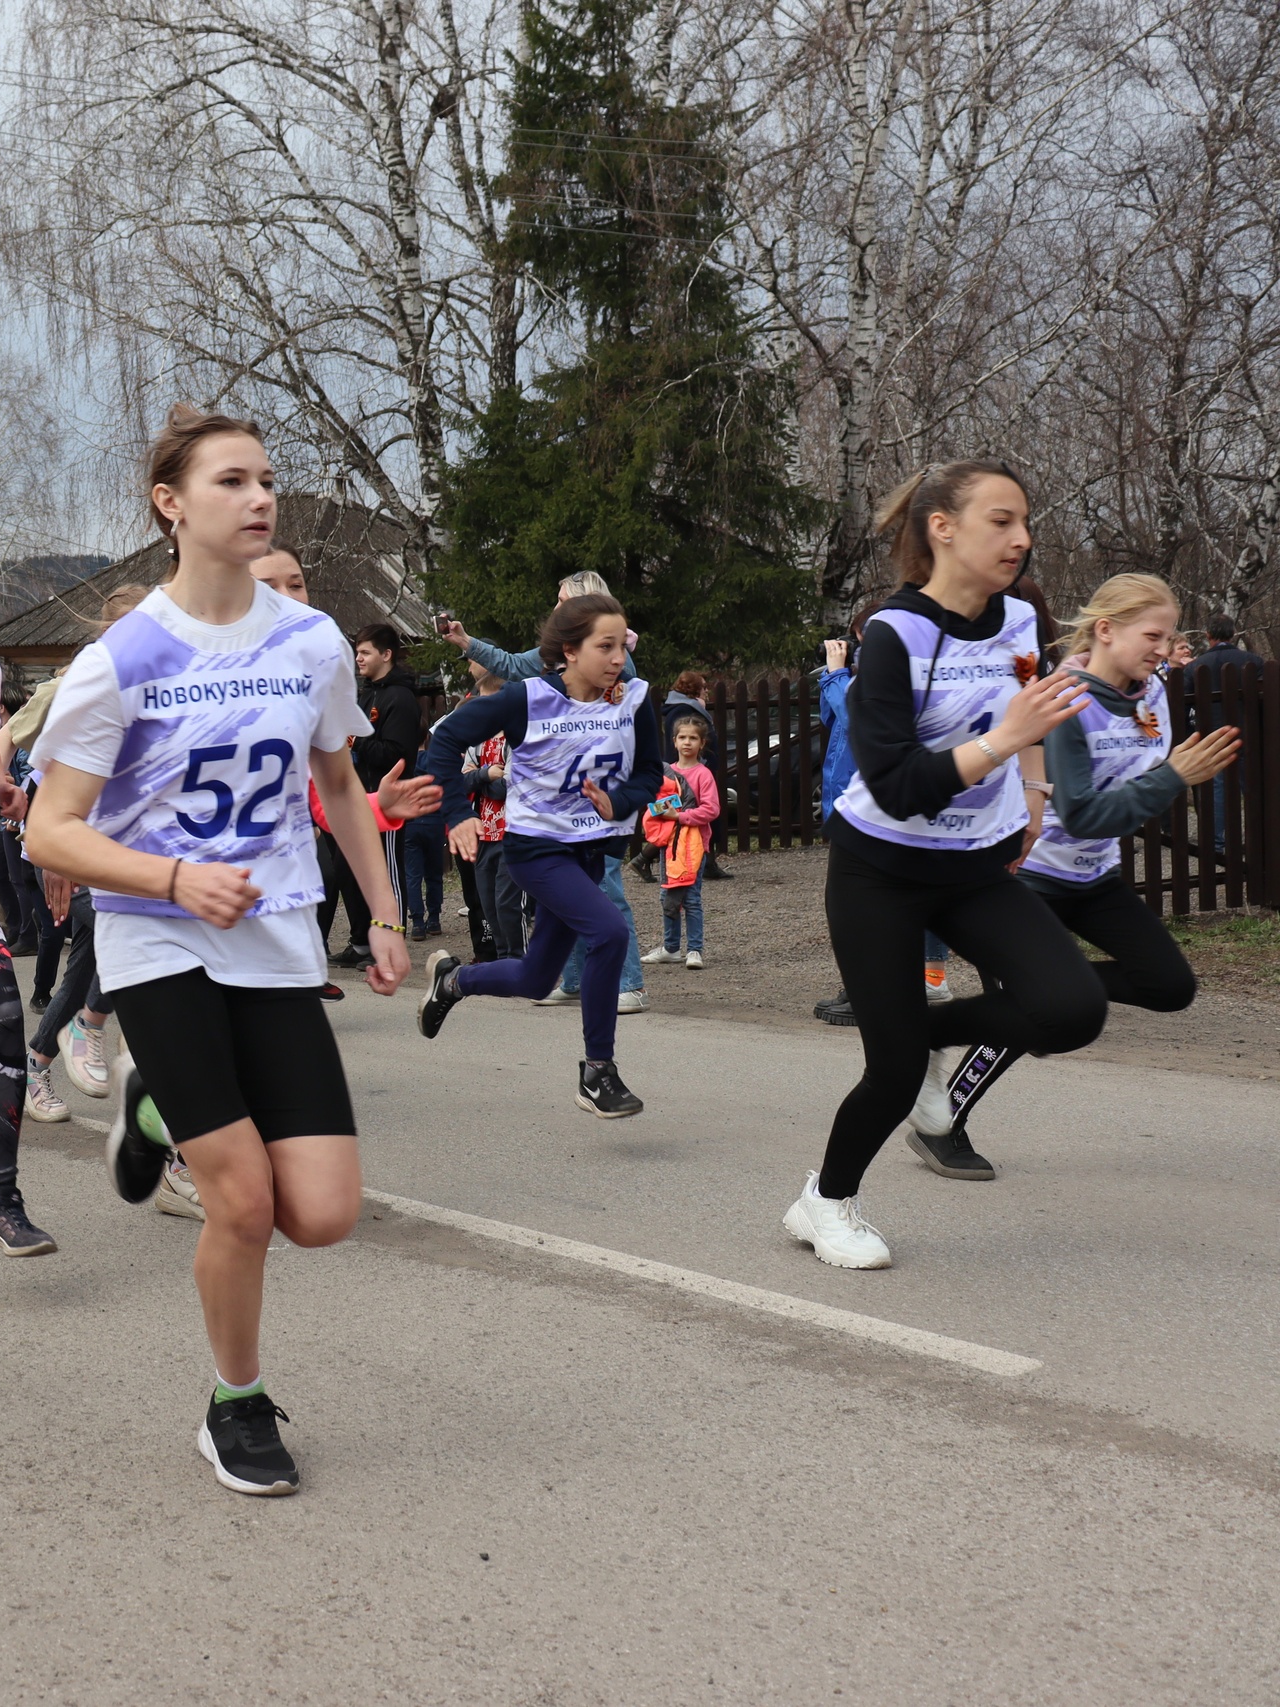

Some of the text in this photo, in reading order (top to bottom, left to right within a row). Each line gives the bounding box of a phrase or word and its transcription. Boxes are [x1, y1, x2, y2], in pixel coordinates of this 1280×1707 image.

[143, 674, 312, 710] Новокузнецкий
[176, 738, 294, 840] 52
[559, 751, 624, 799] 47
[572, 815, 602, 828] окру
